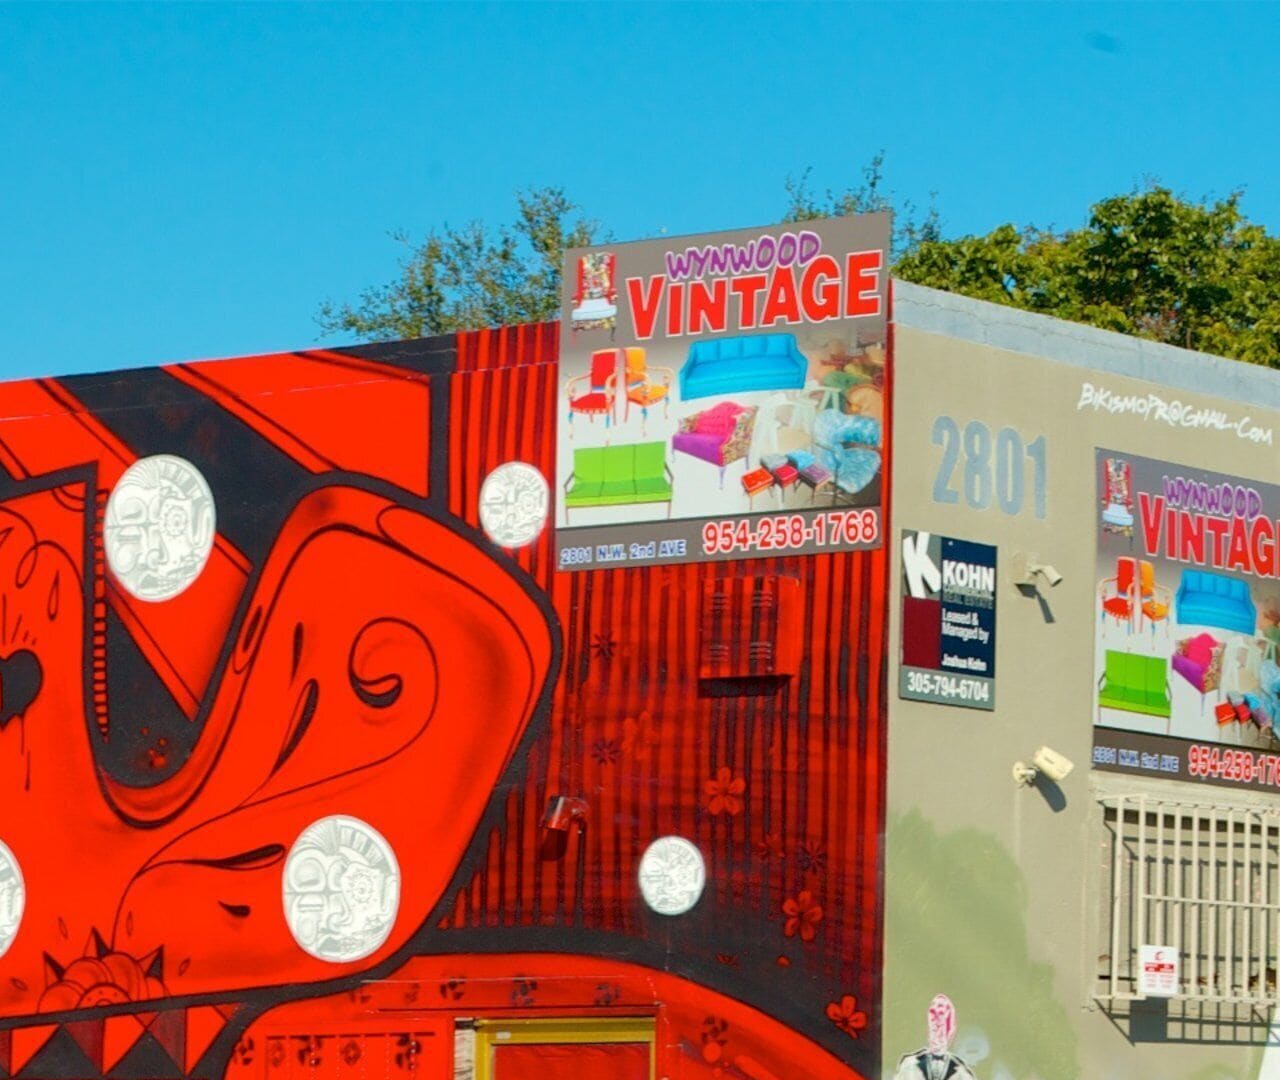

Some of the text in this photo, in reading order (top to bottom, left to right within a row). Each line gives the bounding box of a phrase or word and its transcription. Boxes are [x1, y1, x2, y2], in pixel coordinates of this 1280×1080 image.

[664, 231, 821, 281] WYNWOOD
[626, 250, 883, 340] VINTAGE
[931, 415, 1048, 520] 2801
[1162, 475, 1263, 522] WYNWOOD
[560, 546, 593, 566] 2801
[629, 541, 656, 560] 2nd
[658, 539, 687, 557] AVE
[702, 509, 878, 555] 954-258-1768
[902, 531, 942, 599] K
[942, 559, 995, 592] KOHN
[978, 627, 990, 644] by
[907, 671, 990, 702] 305-794-6704
